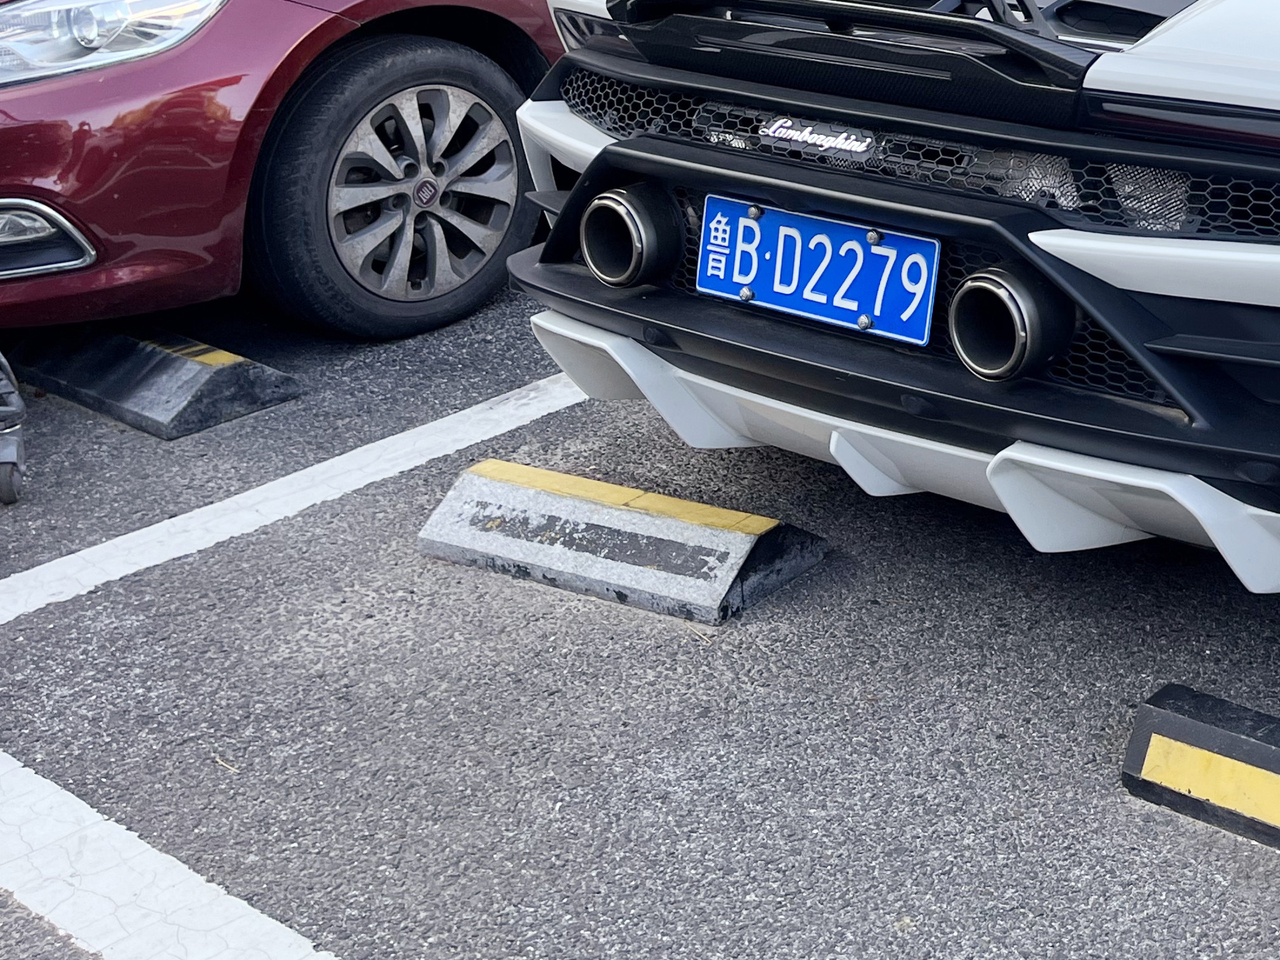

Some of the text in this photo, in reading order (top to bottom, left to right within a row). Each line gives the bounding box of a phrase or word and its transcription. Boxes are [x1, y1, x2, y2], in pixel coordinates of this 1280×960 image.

[759, 118, 872, 153] Lamborghini
[418, 183, 435, 203] FIAT
[706, 211, 929, 323] 鲁B·D2279
